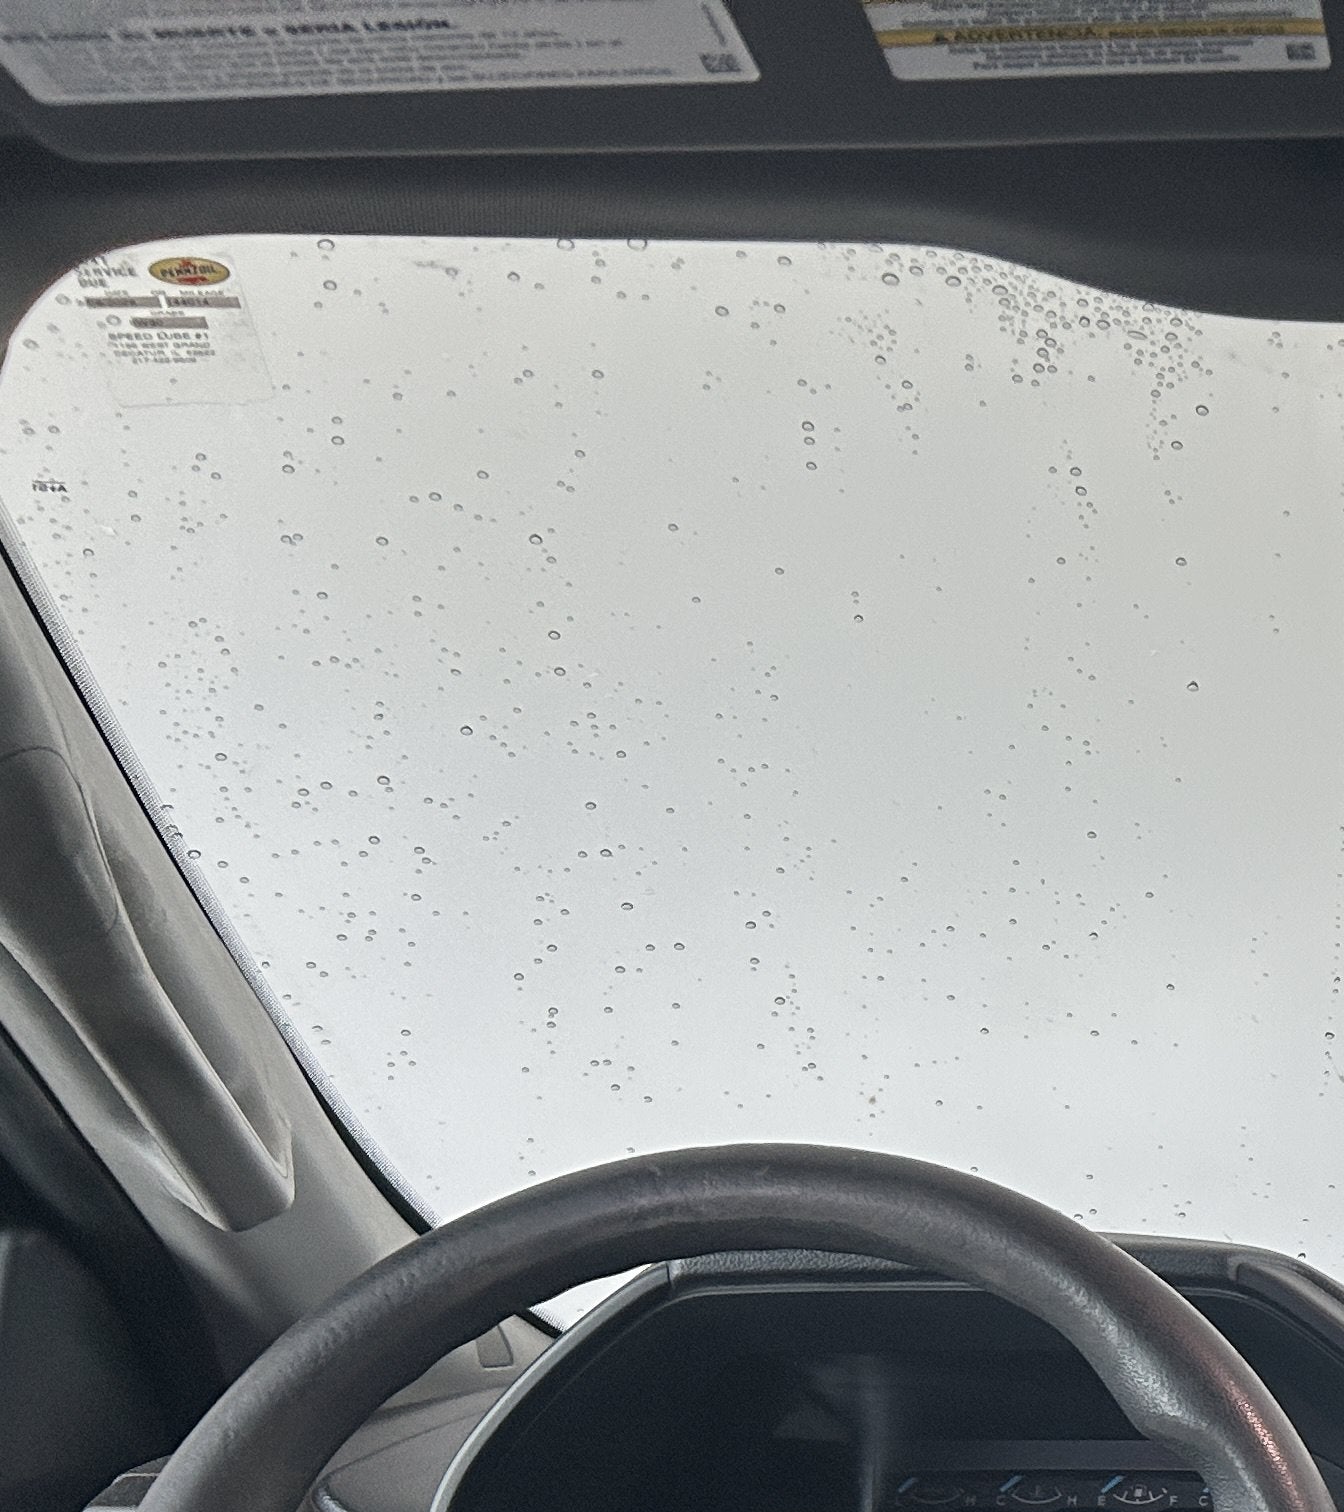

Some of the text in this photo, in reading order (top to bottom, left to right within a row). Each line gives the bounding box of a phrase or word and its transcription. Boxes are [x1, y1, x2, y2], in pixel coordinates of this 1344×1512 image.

[160, 264, 217, 278] PENNZOIL
[108, 332, 153, 341] SPEED
[157, 332, 191, 341] LUBE
[1068, 1496, 1077, 1506] H
[1098, 1496, 1106, 1506] E
[1169, 1496, 1178, 1506] F
